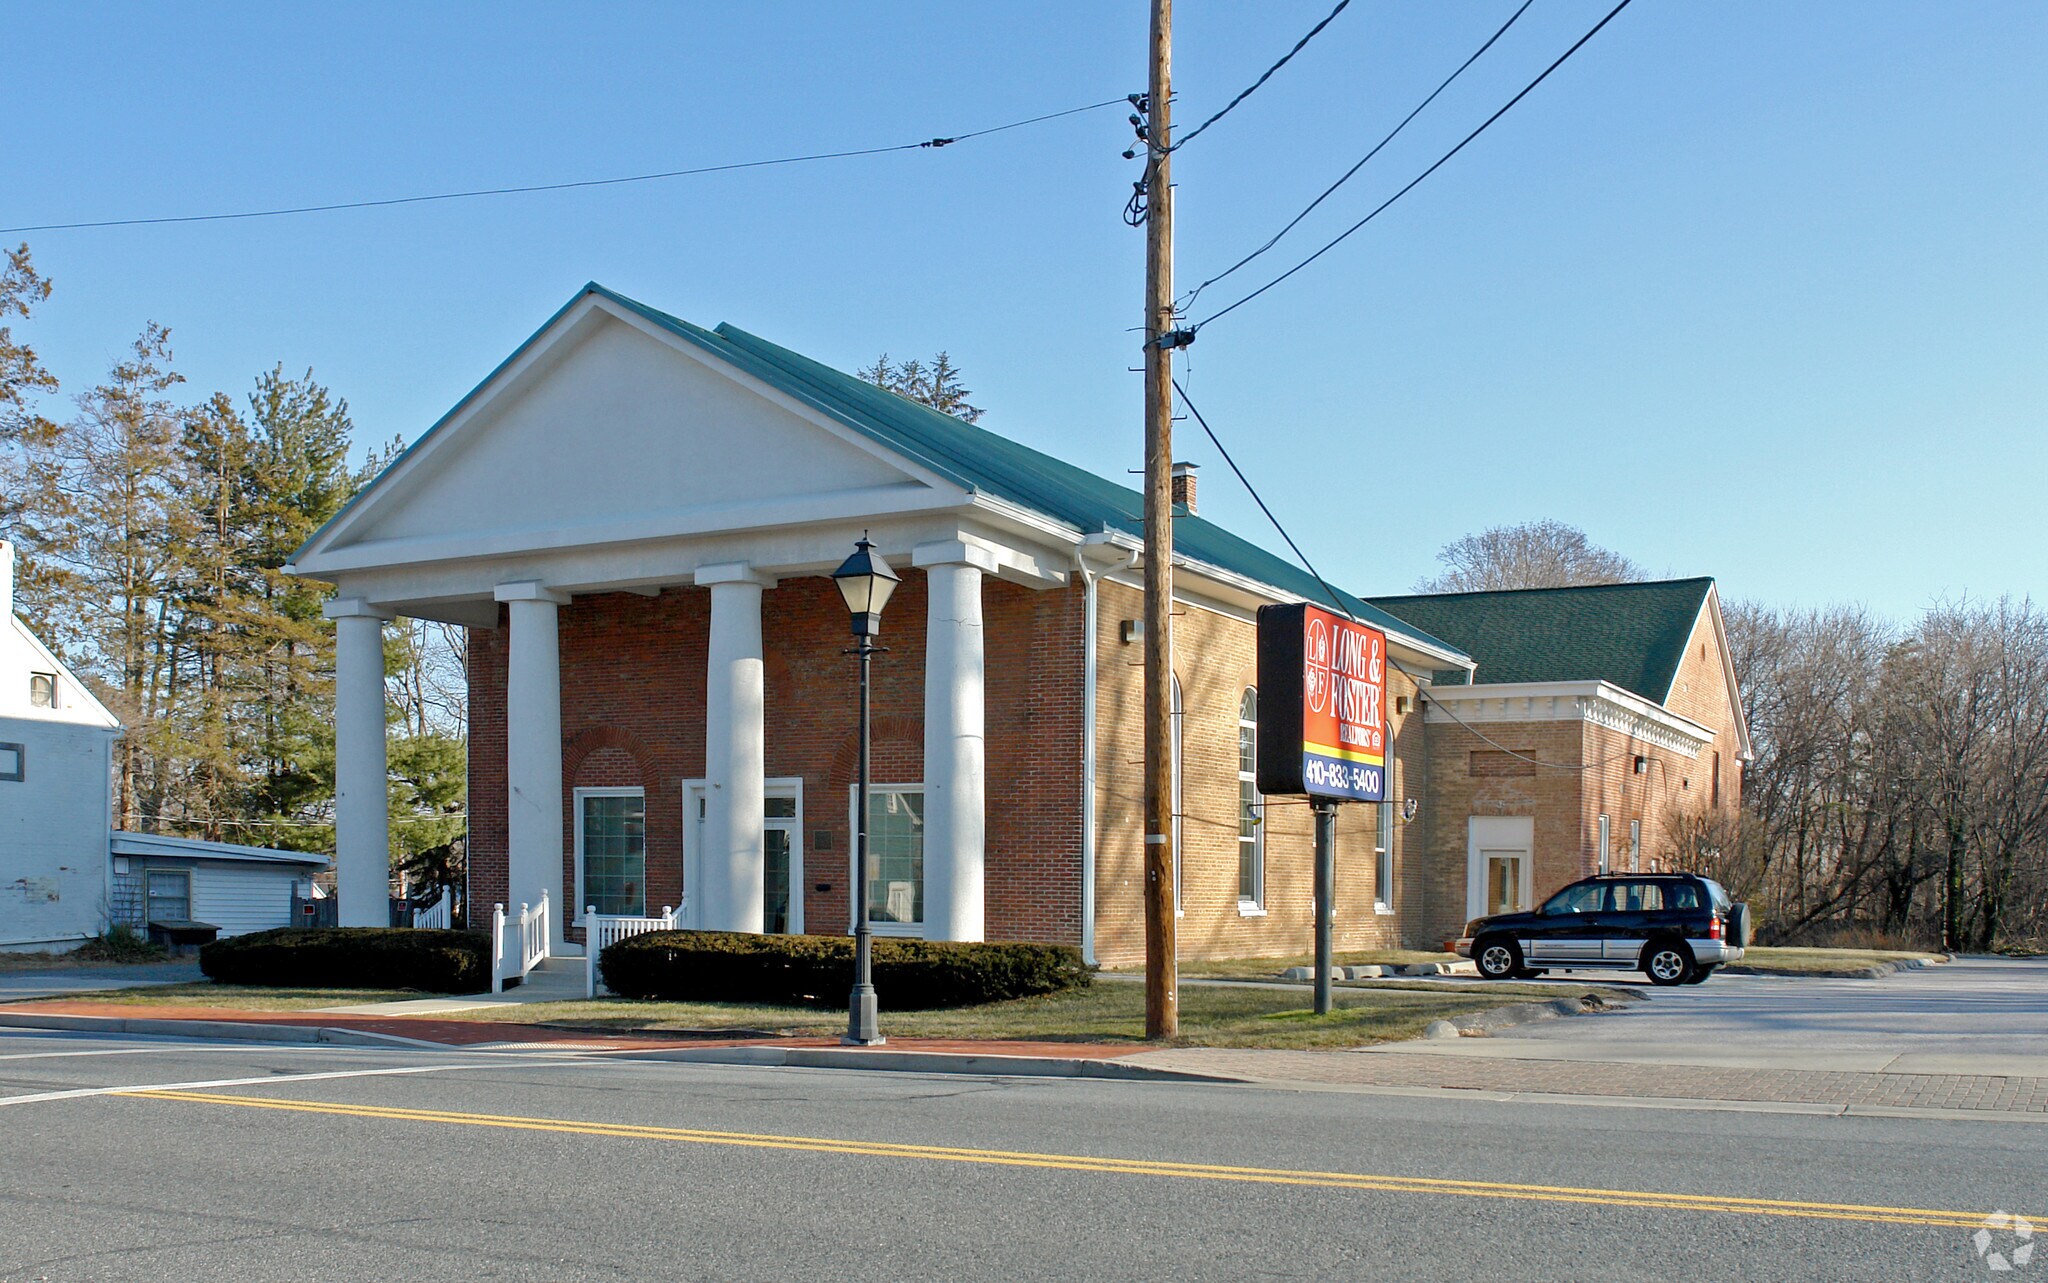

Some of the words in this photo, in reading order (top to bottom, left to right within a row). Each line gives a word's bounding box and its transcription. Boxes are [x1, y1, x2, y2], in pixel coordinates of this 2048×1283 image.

[1308, 636, 1316, 661] L
[1332, 624, 1366, 681] LONG
[1369, 639, 1381, 684] &
[1318, 672, 1325, 695] F
[1330, 673, 1381, 728] FOSTER
[1306, 759, 1379, 794] 410-833-5400
